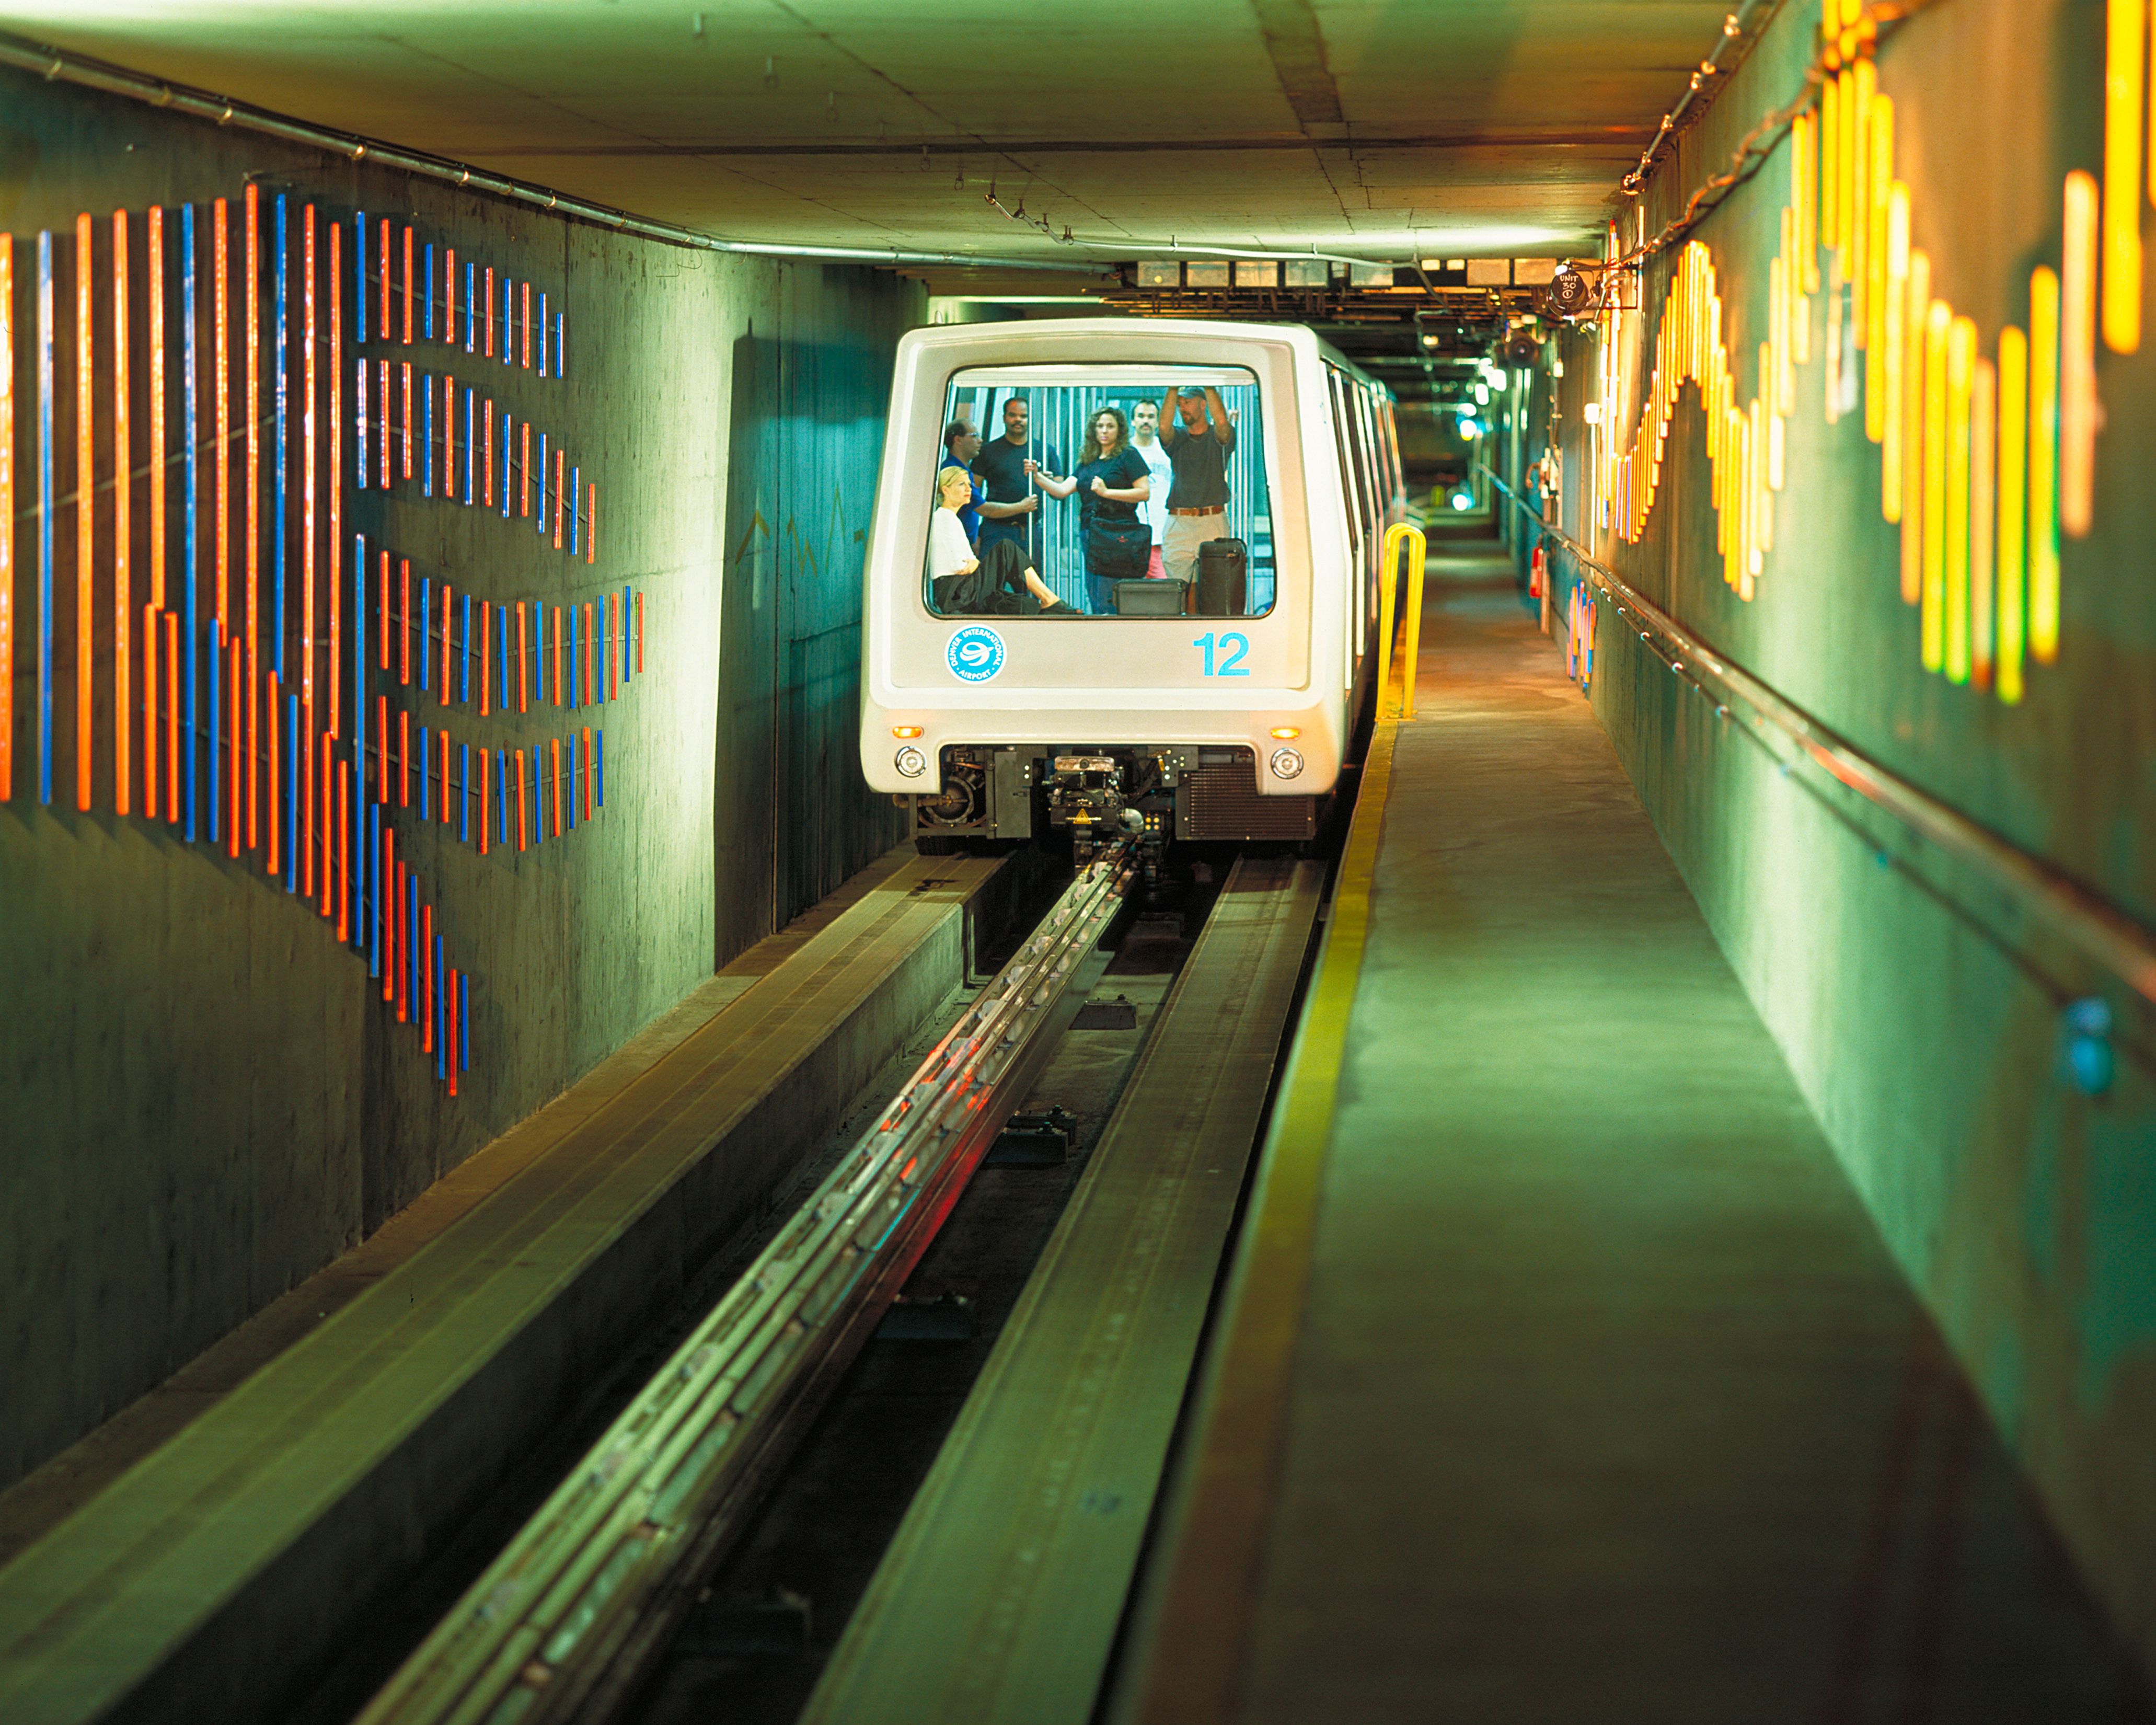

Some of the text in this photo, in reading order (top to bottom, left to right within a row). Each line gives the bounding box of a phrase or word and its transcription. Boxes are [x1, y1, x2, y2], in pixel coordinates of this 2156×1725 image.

[949, 628, 1002, 667] DENVER INTERNATIONAL
[1193, 632, 1250, 676] 12
[959, 669, 991, 680] AIRPORT
